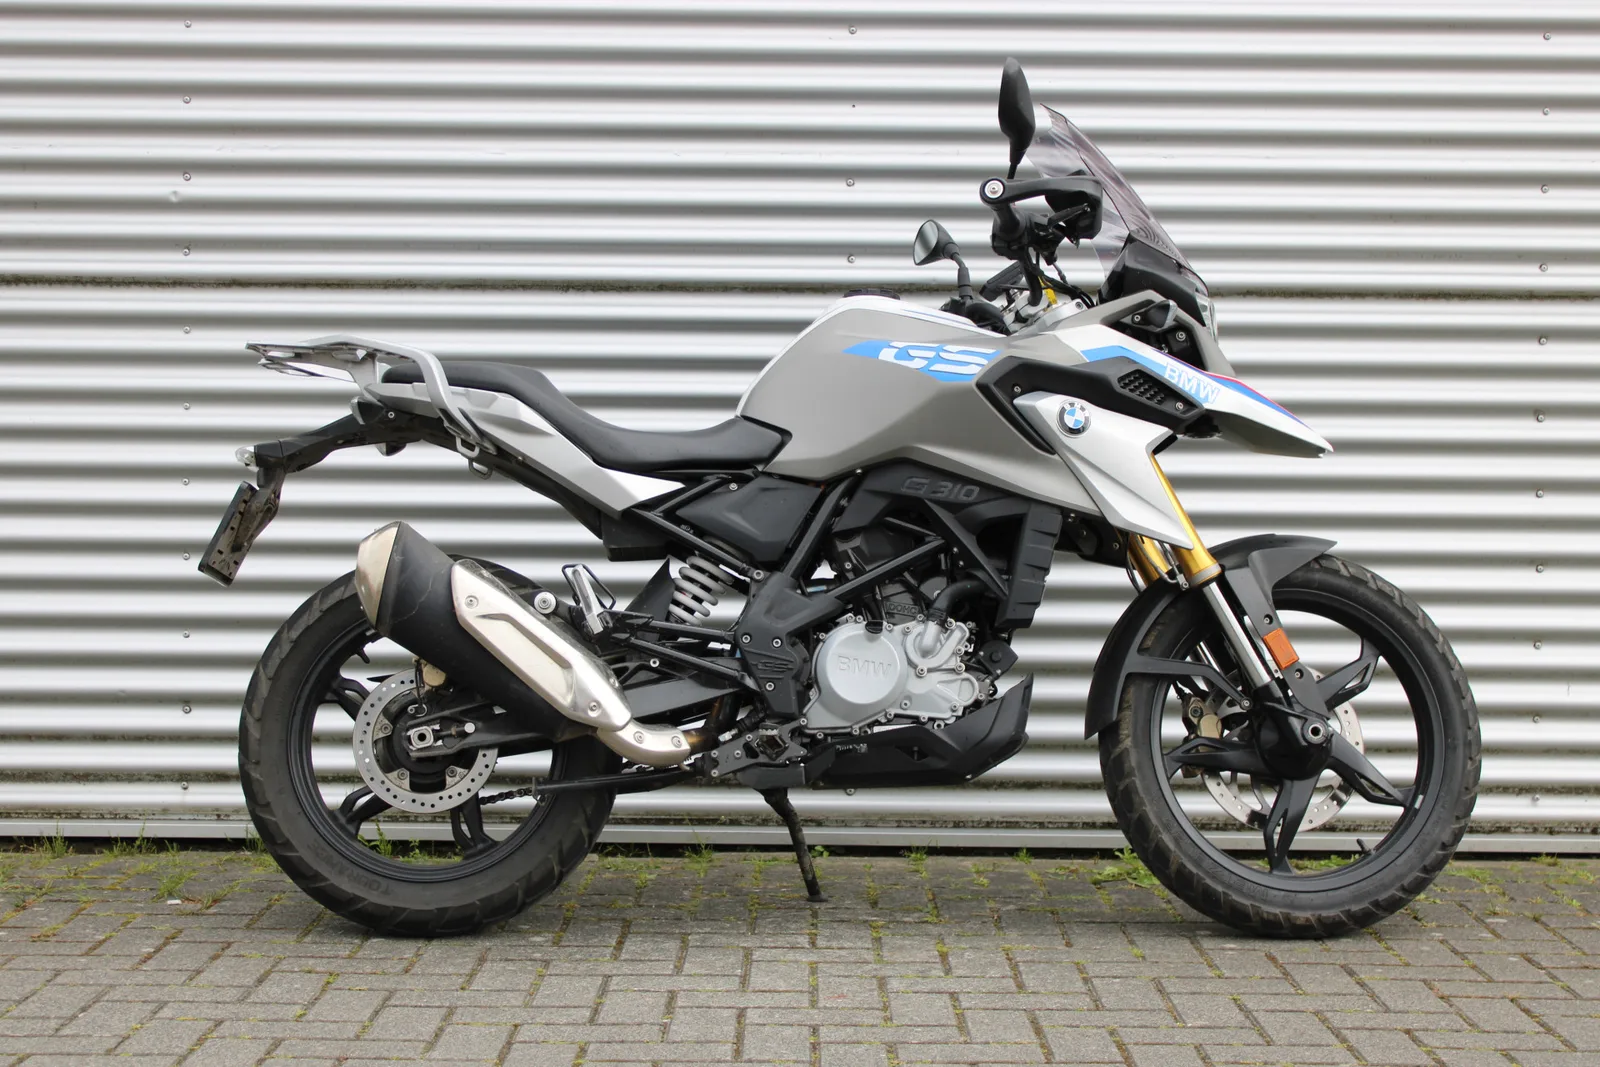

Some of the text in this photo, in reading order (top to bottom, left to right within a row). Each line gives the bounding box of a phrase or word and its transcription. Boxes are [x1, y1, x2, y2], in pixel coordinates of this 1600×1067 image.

[878, 341, 997, 375] GS
[1164, 361, 1221, 404] BMW
[901, 476, 980, 500] G 310
[836, 654, 893, 676] BMW
[306, 838, 393, 896] TOURANCE
